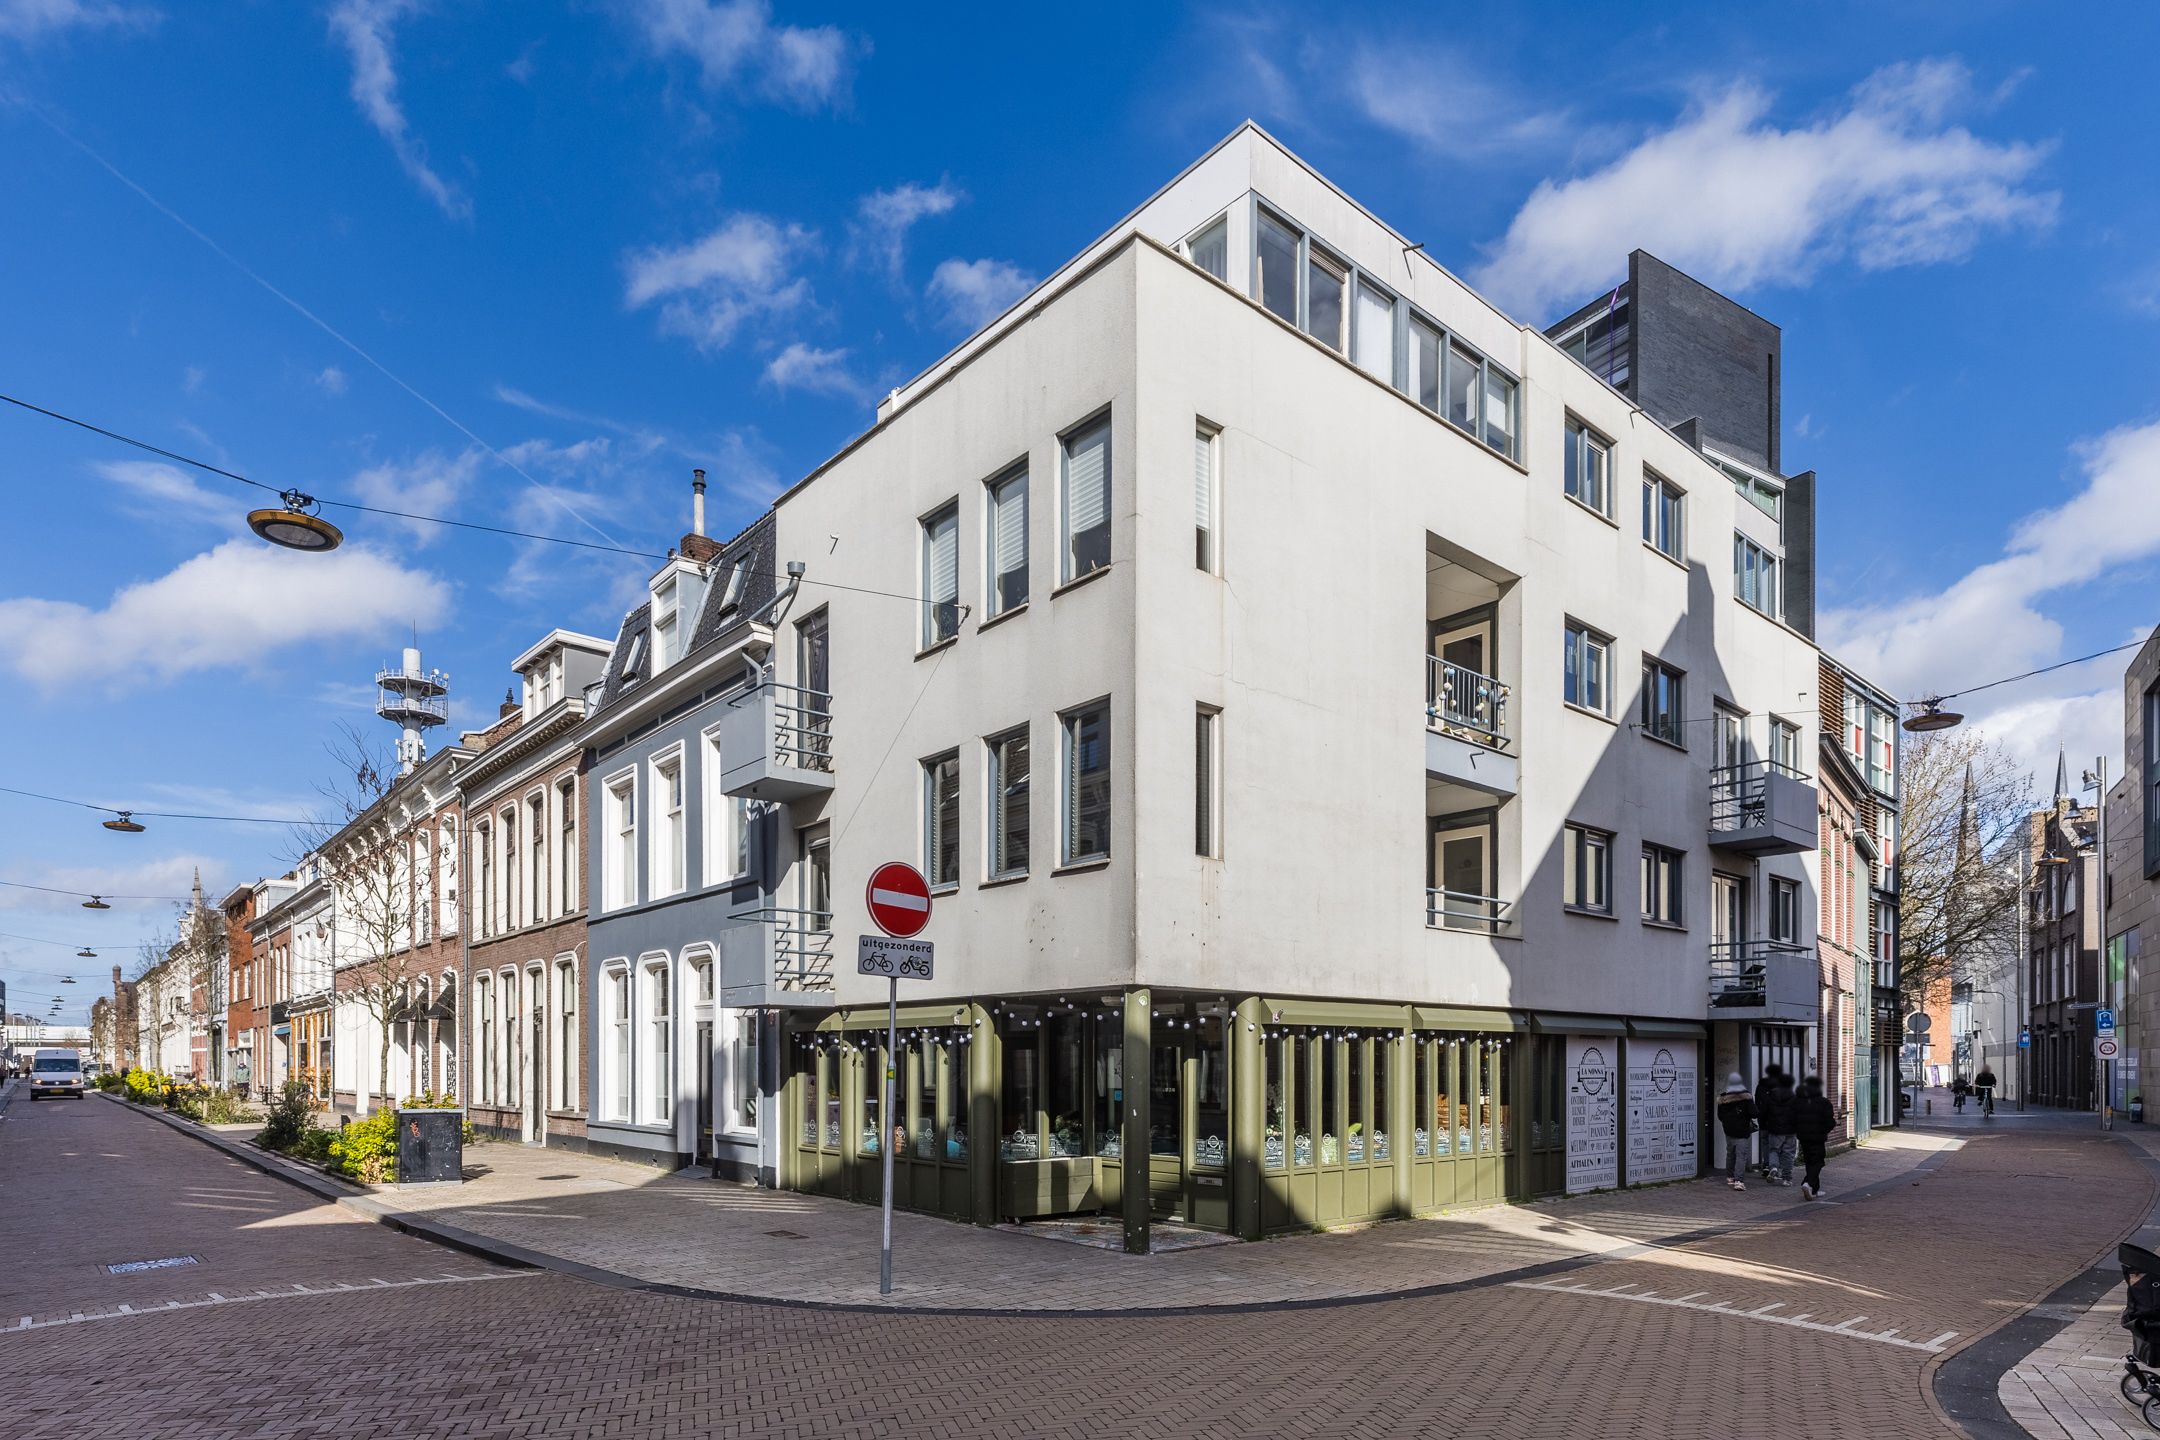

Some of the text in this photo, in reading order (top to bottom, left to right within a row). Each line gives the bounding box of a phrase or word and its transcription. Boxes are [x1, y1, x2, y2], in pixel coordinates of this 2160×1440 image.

[862, 939, 932, 953] uitgezonderd
[1645, 1105, 1669, 1118] SALADES
[1572, 1116, 1586, 1126] DINER
[1590, 1126, 1608, 1138] PANINI
[1678, 1121, 1695, 1141] VLEES
[1671, 1163, 1695, 1174] CATERING
